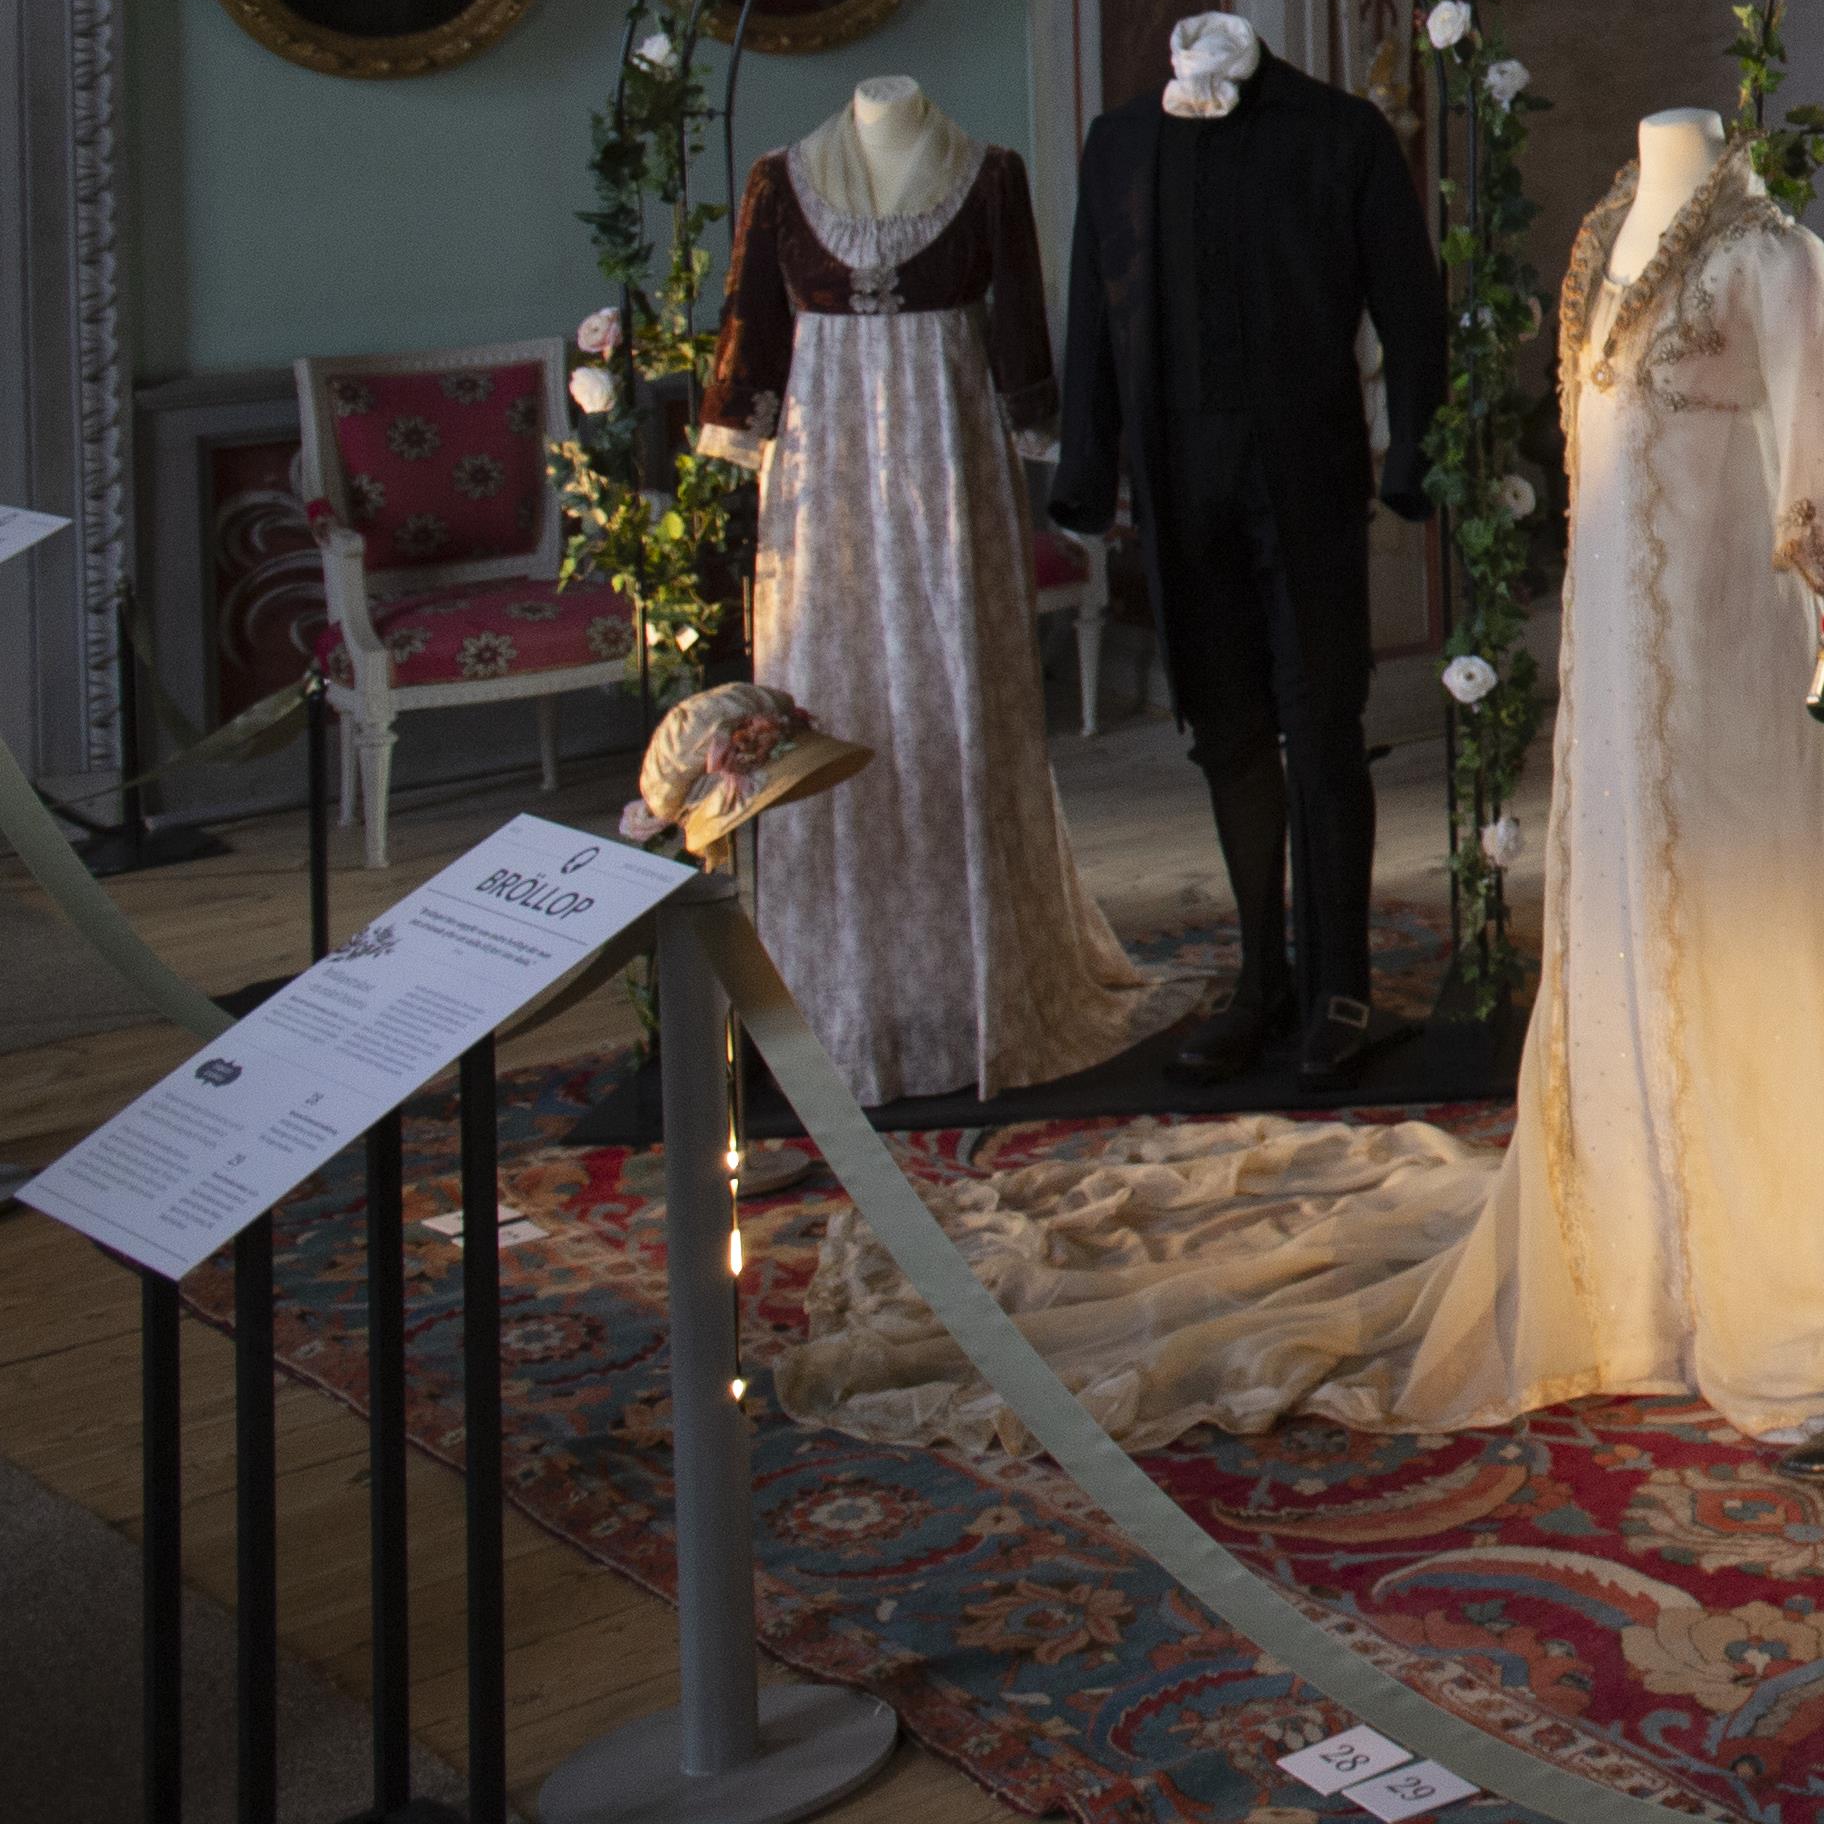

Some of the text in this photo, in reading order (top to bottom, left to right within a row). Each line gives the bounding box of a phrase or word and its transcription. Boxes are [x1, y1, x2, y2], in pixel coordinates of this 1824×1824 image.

[475, 869, 595, 920] BRÖLLOP
[1318, 1743, 1371, 1773] 28
[1385, 1776, 1437, 1803] 29
